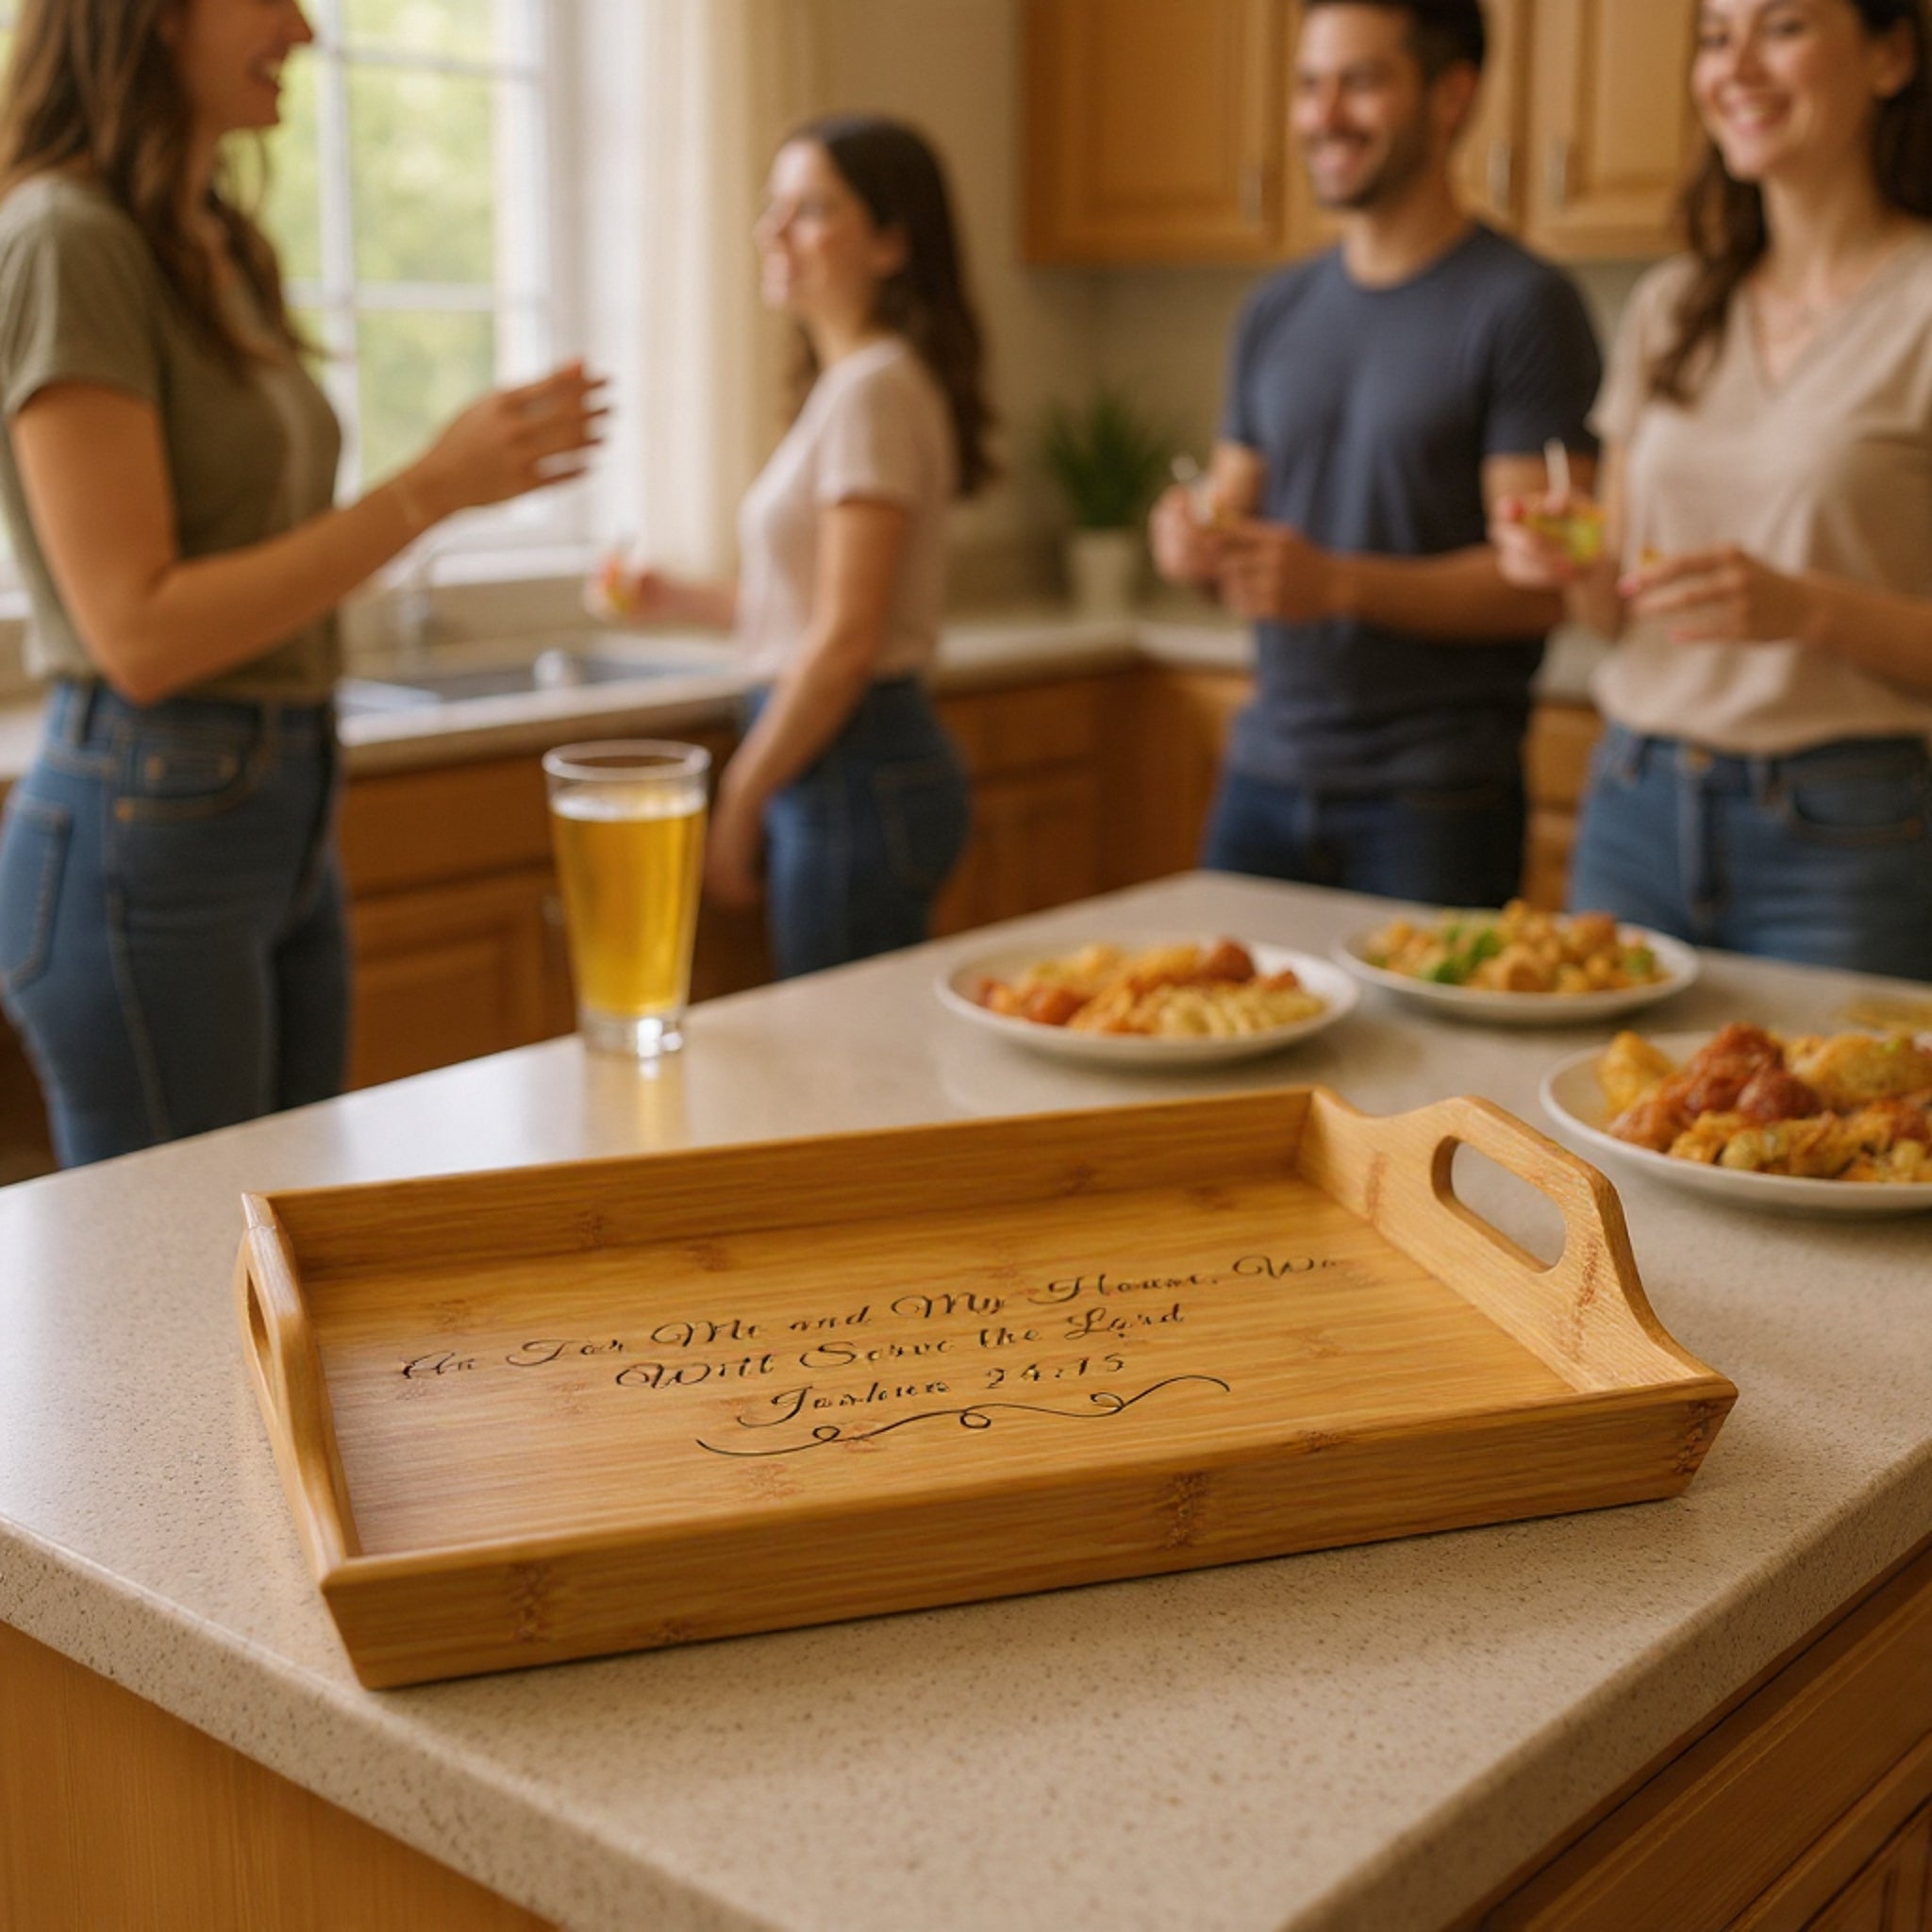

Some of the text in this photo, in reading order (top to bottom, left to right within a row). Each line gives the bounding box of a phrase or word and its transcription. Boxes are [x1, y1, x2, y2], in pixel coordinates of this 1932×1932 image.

[615, 1303, 1186, 1390] Will Serve the Lord
[651, 1320, 761, 1347] Me
[789, 1305, 872, 1332] and
[891, 1291, 1006, 1318] My
[985, 1353, 1125, 1390] 24:15
